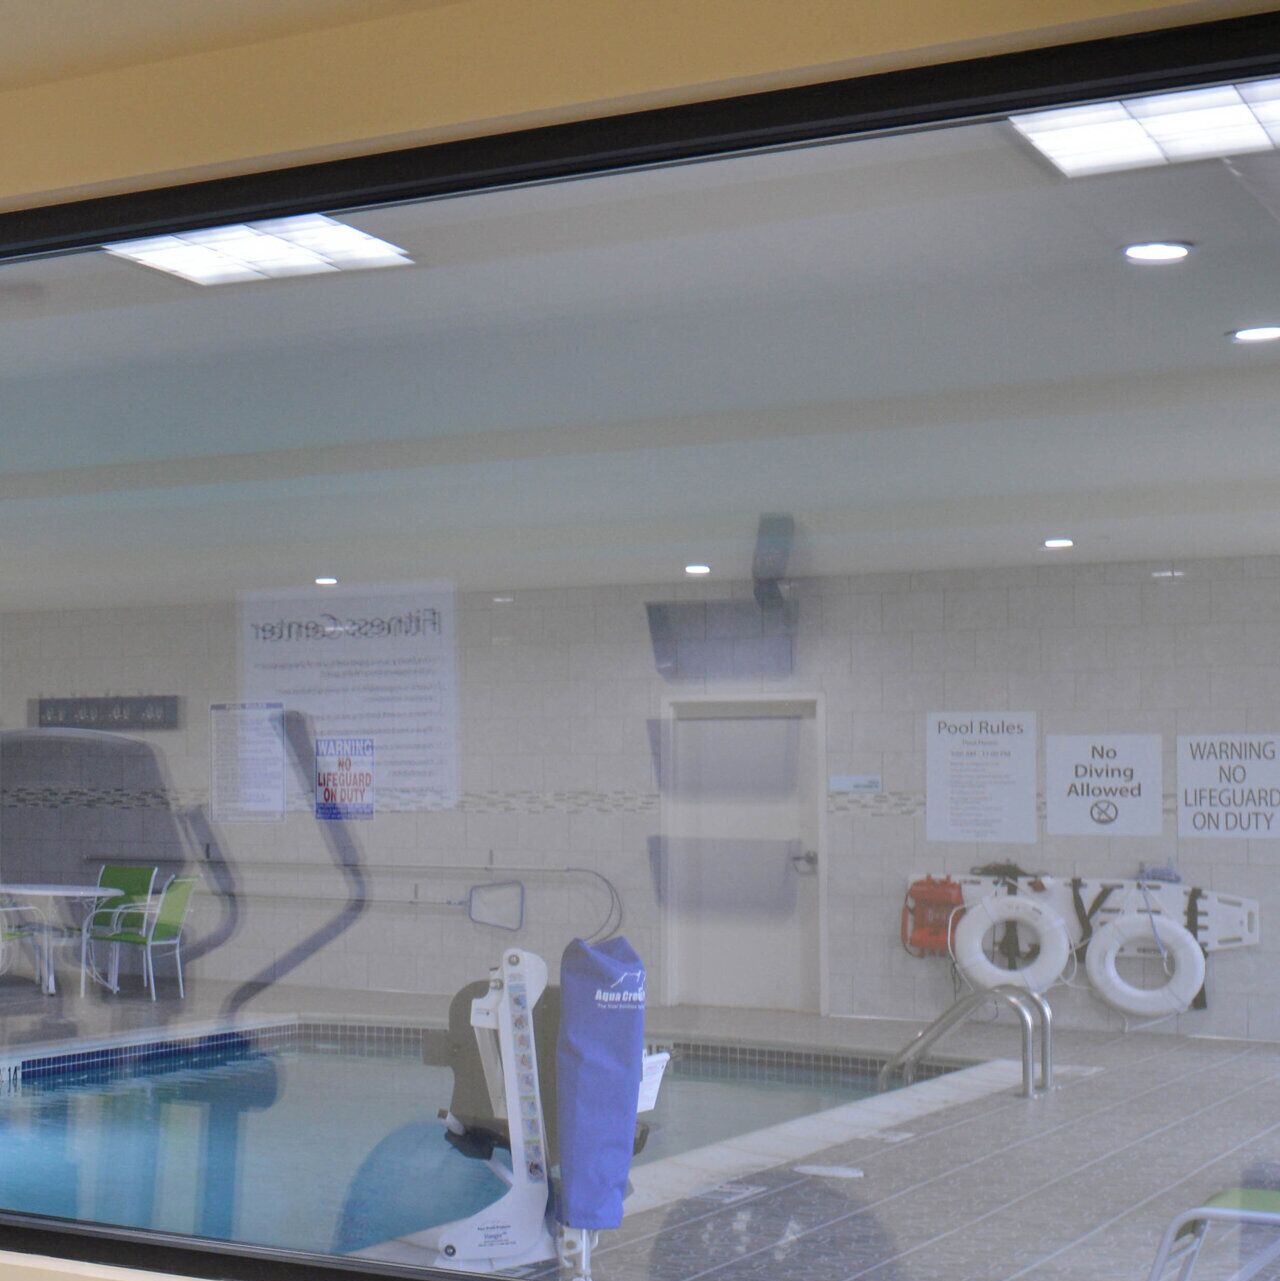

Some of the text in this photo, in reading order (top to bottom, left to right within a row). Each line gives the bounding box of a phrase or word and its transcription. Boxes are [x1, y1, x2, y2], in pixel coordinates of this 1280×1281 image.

[937, 719, 1025, 735] Pool Rules
[317, 740, 373, 756] WARNING
[1091, 745, 1117, 760] No
[1189, 741, 1276, 761] WARNING
[337, 757, 352, 772] NO
[1073, 763, 1135, 782] Diving
[317, 772, 372, 787] LIFEGUARD
[1218, 764, 1247, 784] NO
[323, 787, 337, 803] ON
[340, 787, 366, 803] DUTY
[1066, 782, 1142, 798] Allowed
[1183, 788, 1280, 808] LIFEGUARD
[1192, 811, 1275, 831] ON DUTY
